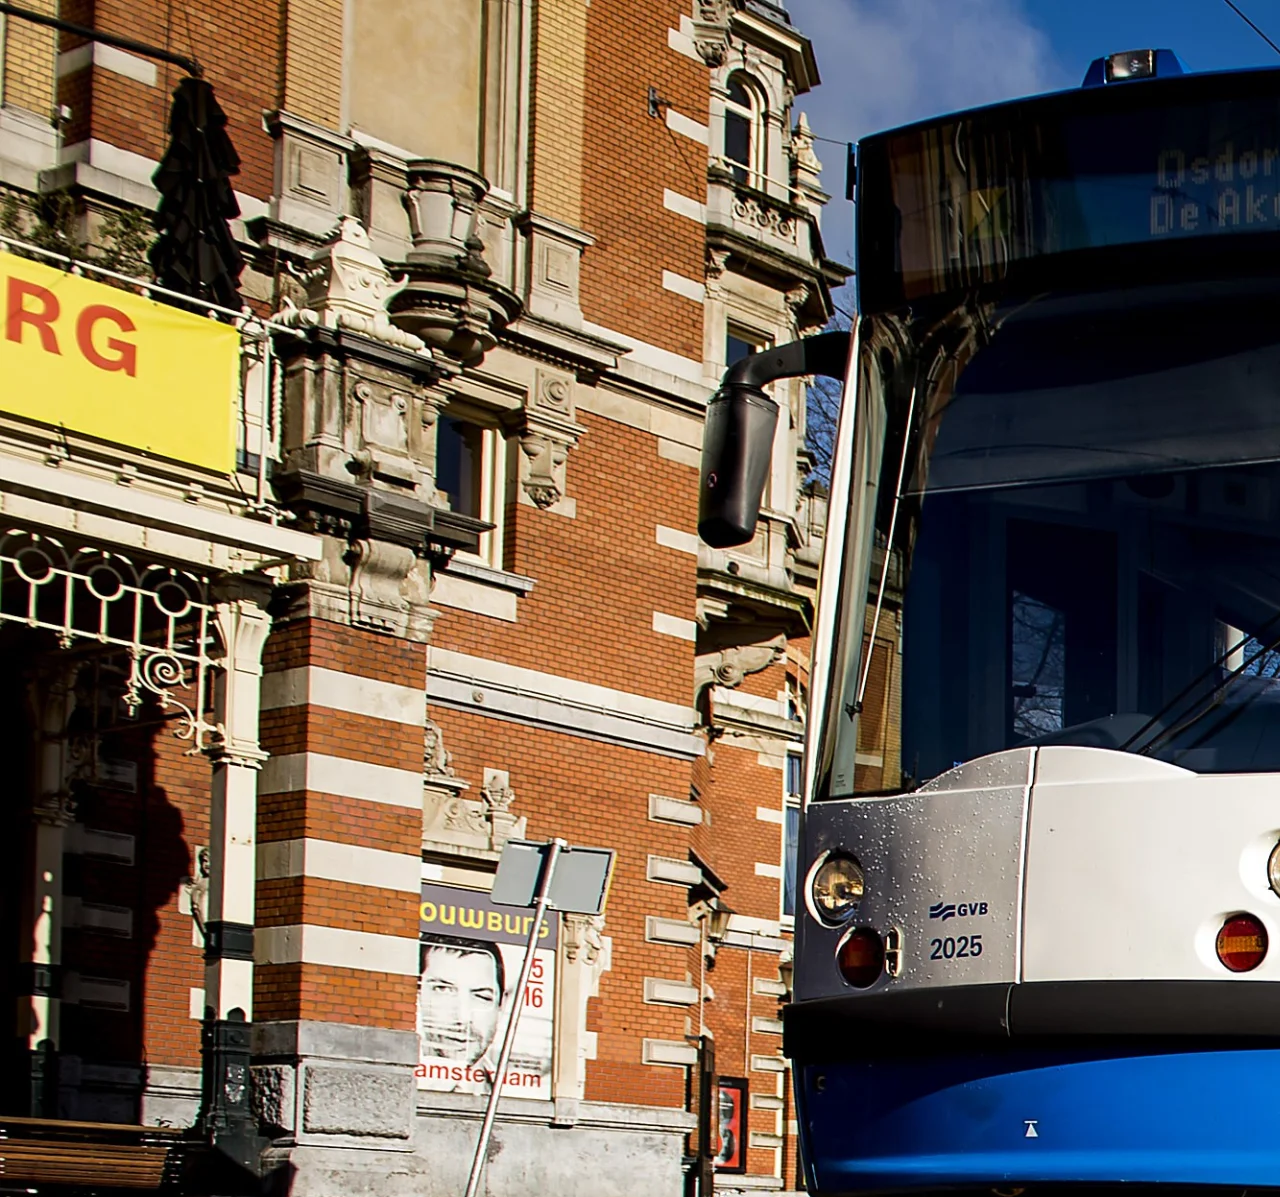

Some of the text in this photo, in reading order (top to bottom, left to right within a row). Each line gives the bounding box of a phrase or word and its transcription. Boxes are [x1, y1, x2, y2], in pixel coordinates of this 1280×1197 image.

[1150, 194, 1198, 235] De
[5, 275, 137, 378] RG
[957, 902, 989, 917] GVB
[930, 934, 983, 961] 2025
